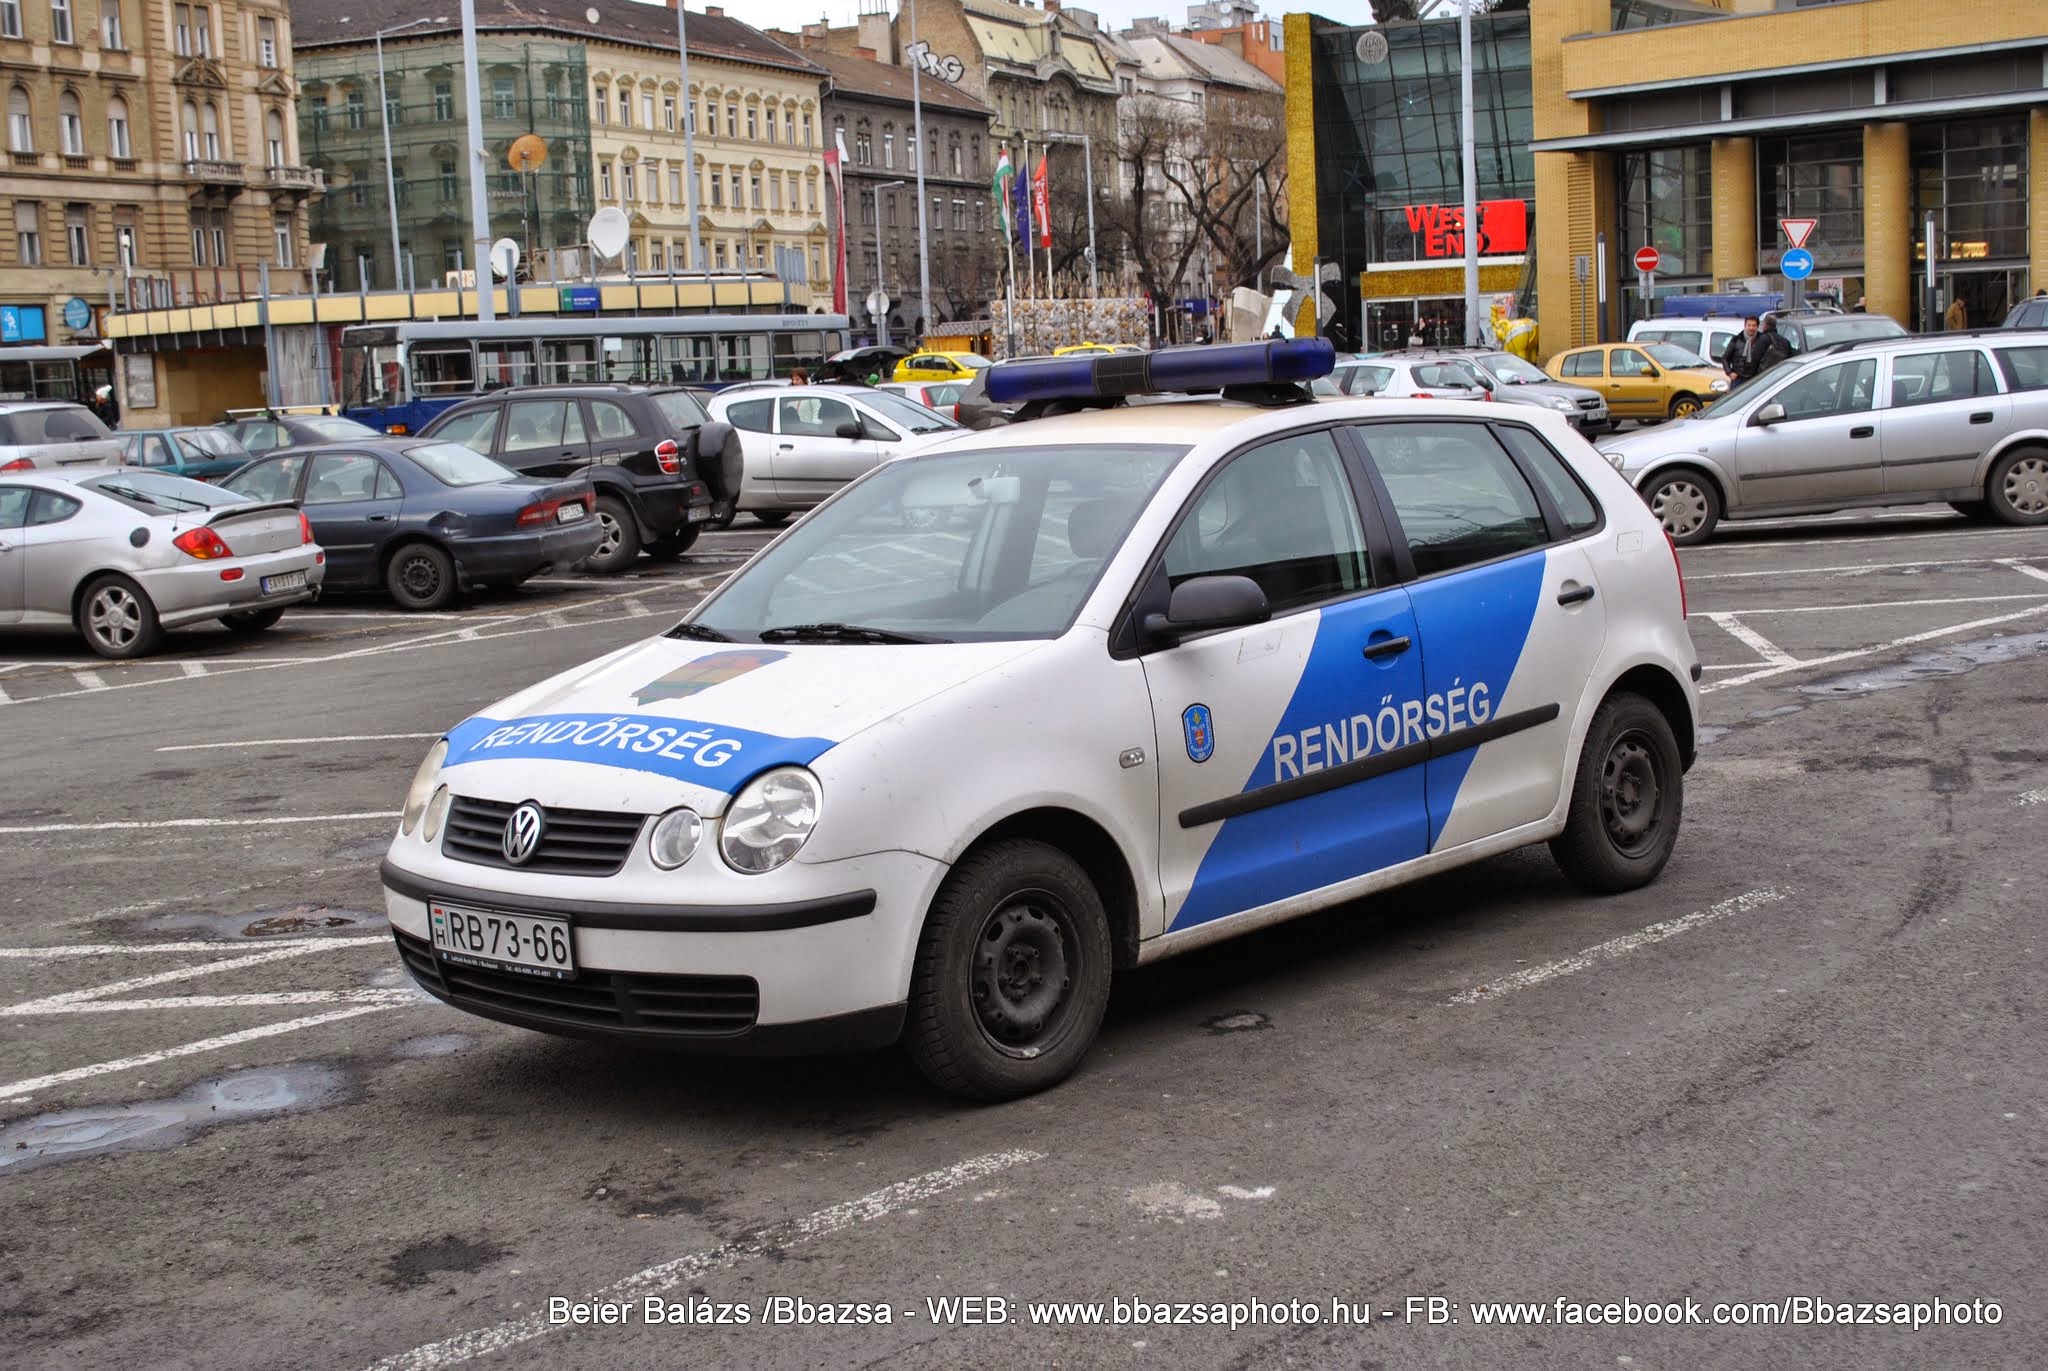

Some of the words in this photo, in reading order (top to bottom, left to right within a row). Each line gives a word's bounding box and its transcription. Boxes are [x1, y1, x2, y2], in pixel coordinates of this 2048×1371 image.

[469, 717, 742, 767] RENDŐRSÉG
[1273, 677, 1490, 783] RENDŐRSÉG
[435, 928, 446, 945] H
